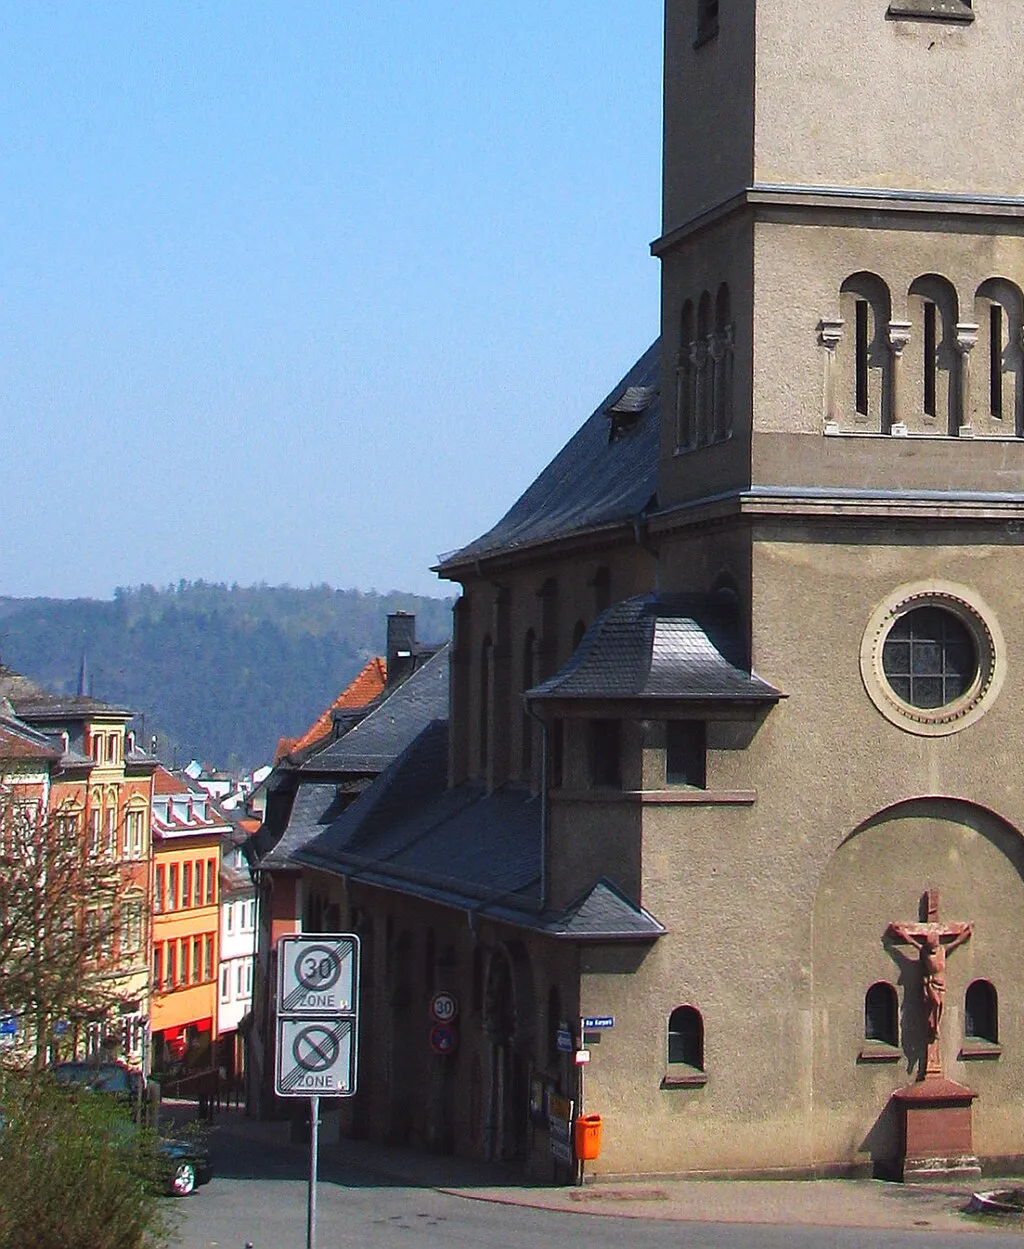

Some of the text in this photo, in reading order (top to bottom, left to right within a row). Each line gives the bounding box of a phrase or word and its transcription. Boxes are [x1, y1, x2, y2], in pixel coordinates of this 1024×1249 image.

[304, 958, 332, 979] 30
[299, 995, 336, 1008] ZONE
[436, 1000, 451, 1014] 30
[297, 1075, 334, 1088] ZONE
